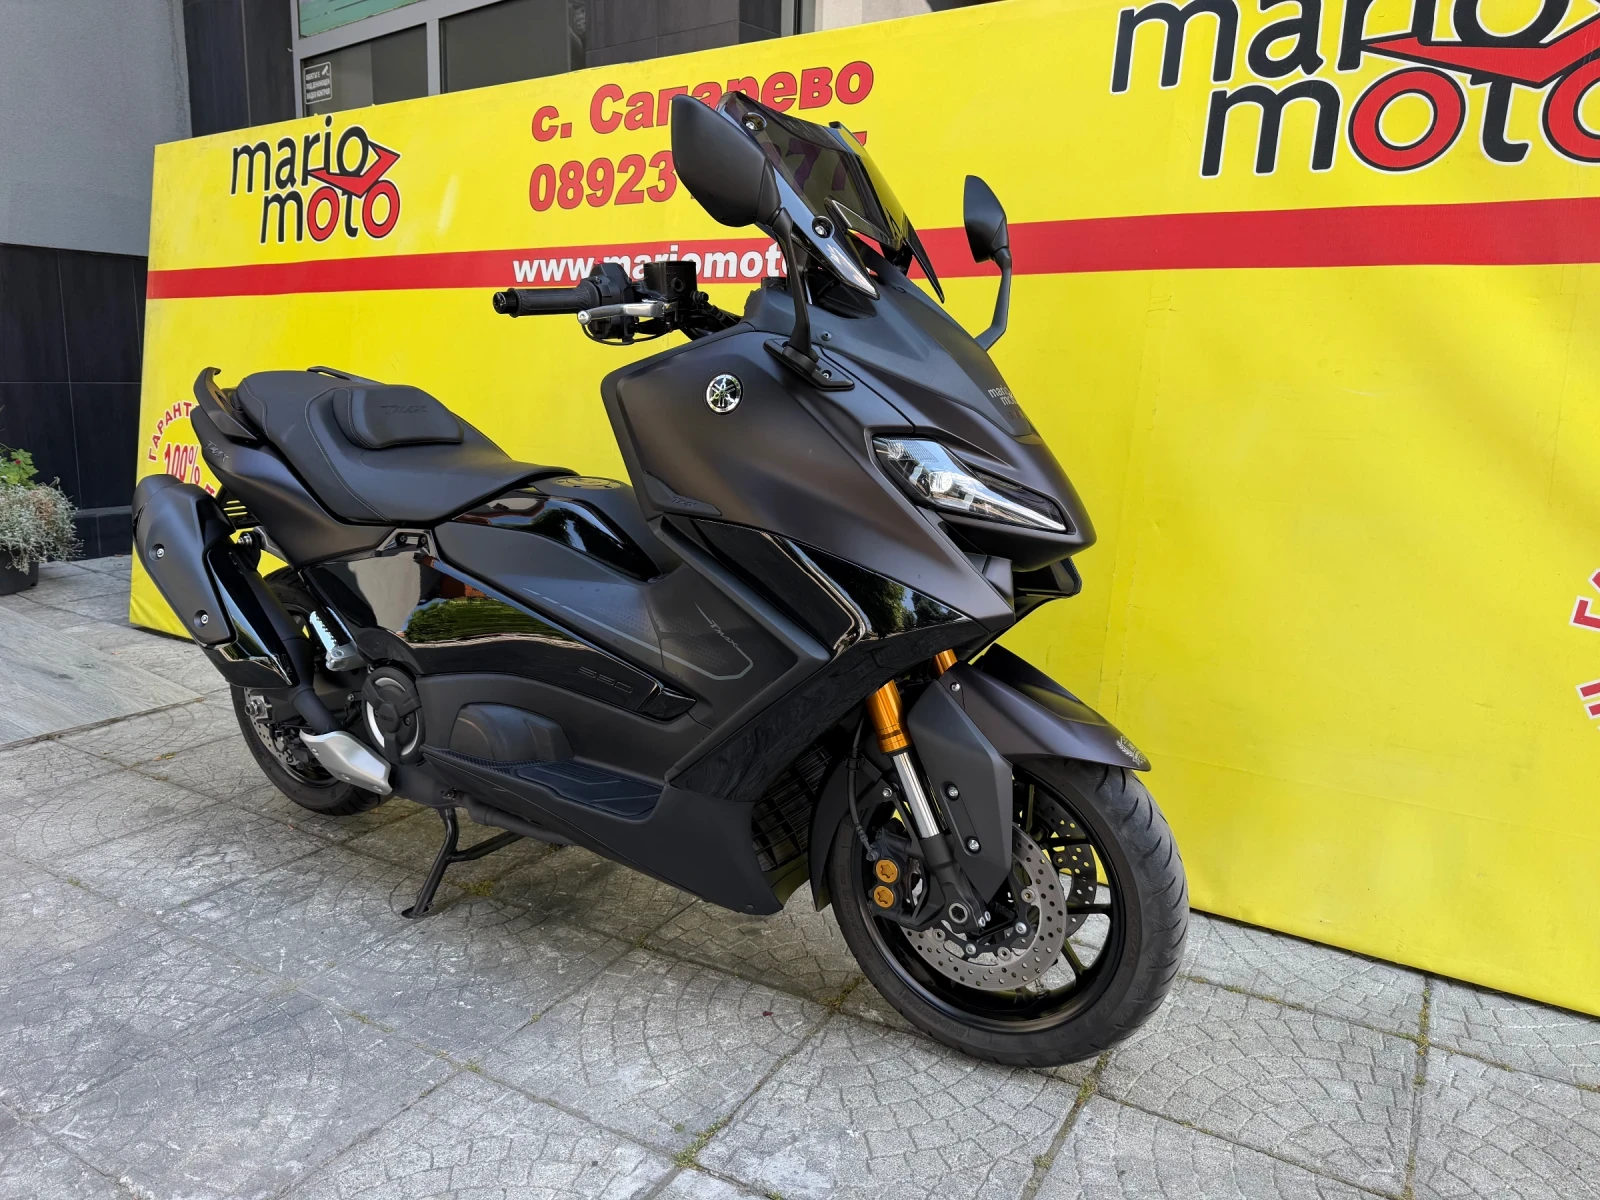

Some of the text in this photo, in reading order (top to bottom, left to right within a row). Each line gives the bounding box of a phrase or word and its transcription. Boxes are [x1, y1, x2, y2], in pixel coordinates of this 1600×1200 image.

[230, 114, 369, 195] mario
[260, 179, 400, 244] moto
[148, 401, 200, 462] ГАРАНТ
[164, 443, 201, 485] 100%
